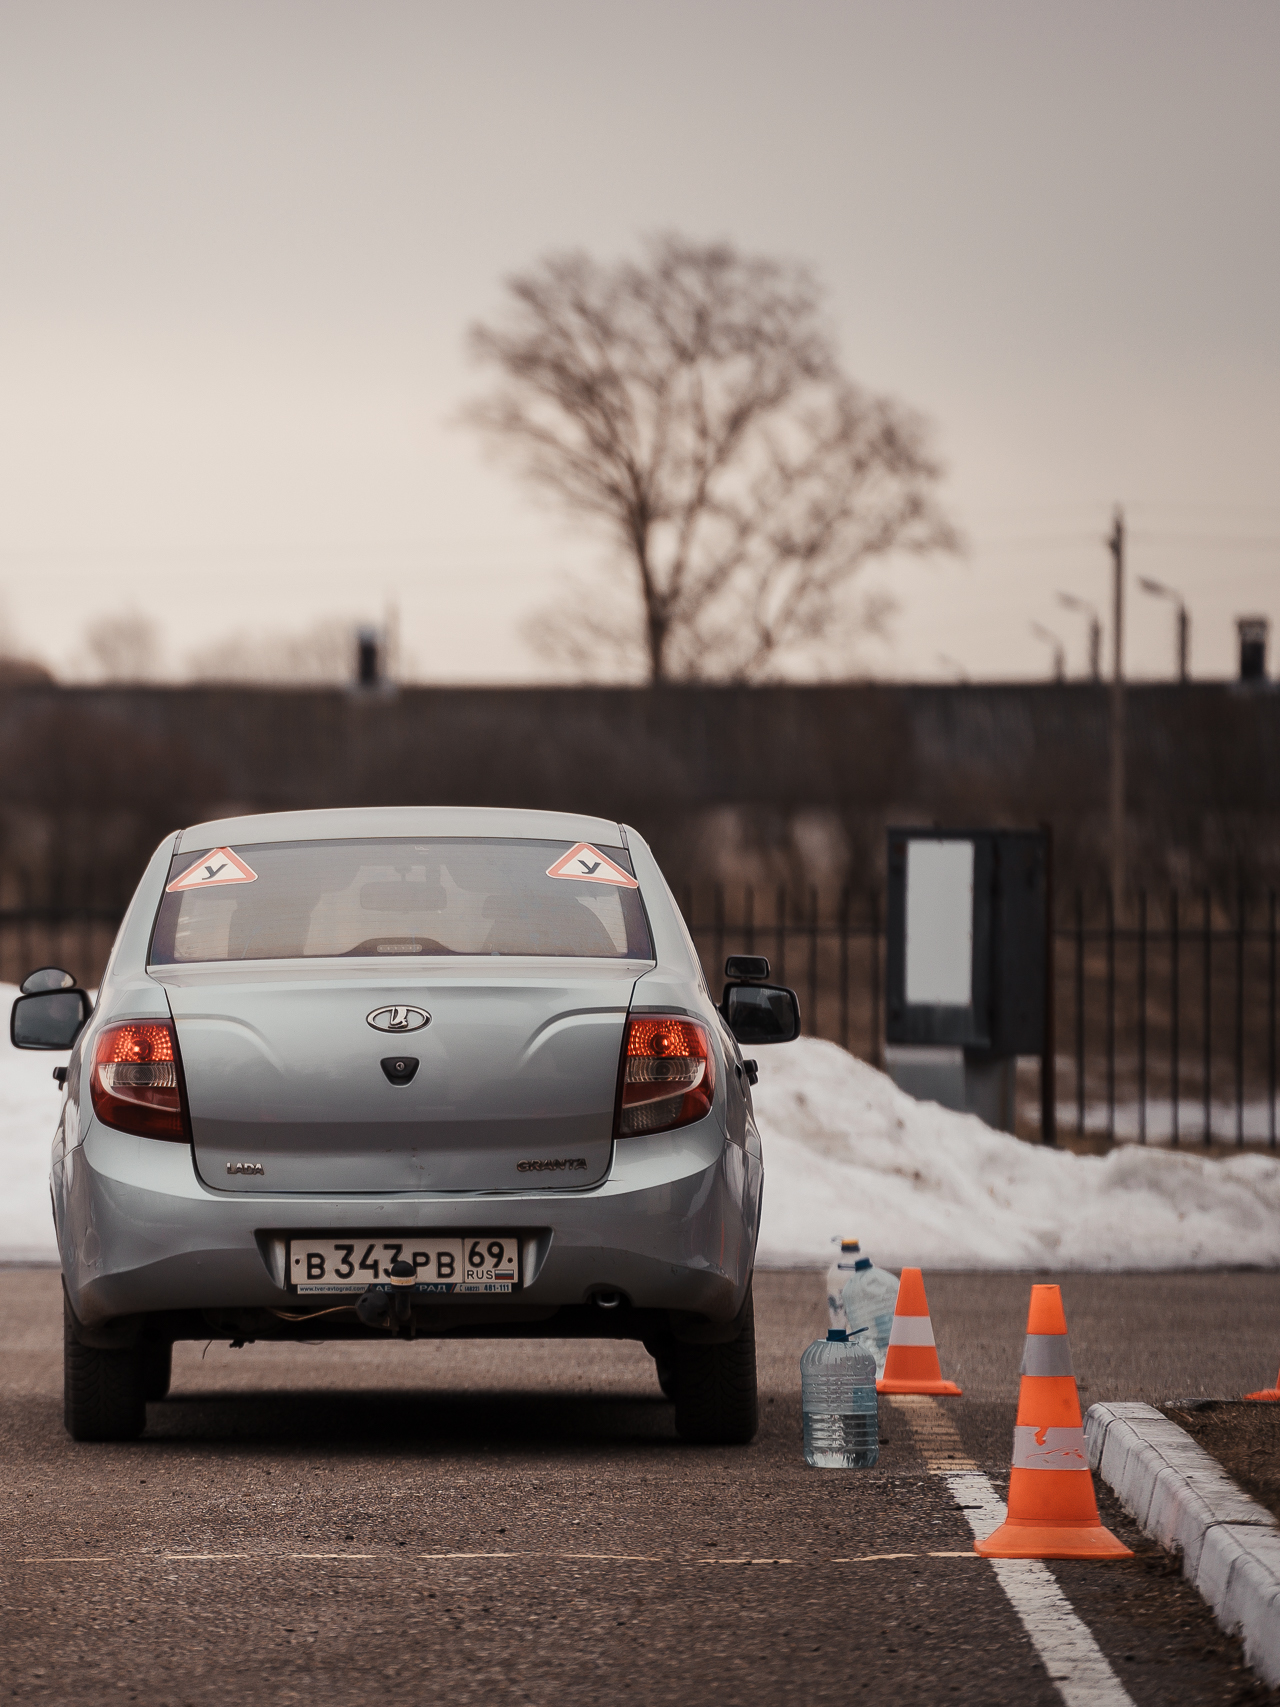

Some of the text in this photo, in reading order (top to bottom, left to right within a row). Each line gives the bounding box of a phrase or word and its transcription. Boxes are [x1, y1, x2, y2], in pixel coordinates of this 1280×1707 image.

[226, 1162, 264, 1175] LADA
[517, 1158, 587, 1172] GRANTA
[468, 1241, 505, 1268] 69
[467, 1270, 493, 1280] RUS
[484, 1284, 510, 1292] 481-111
